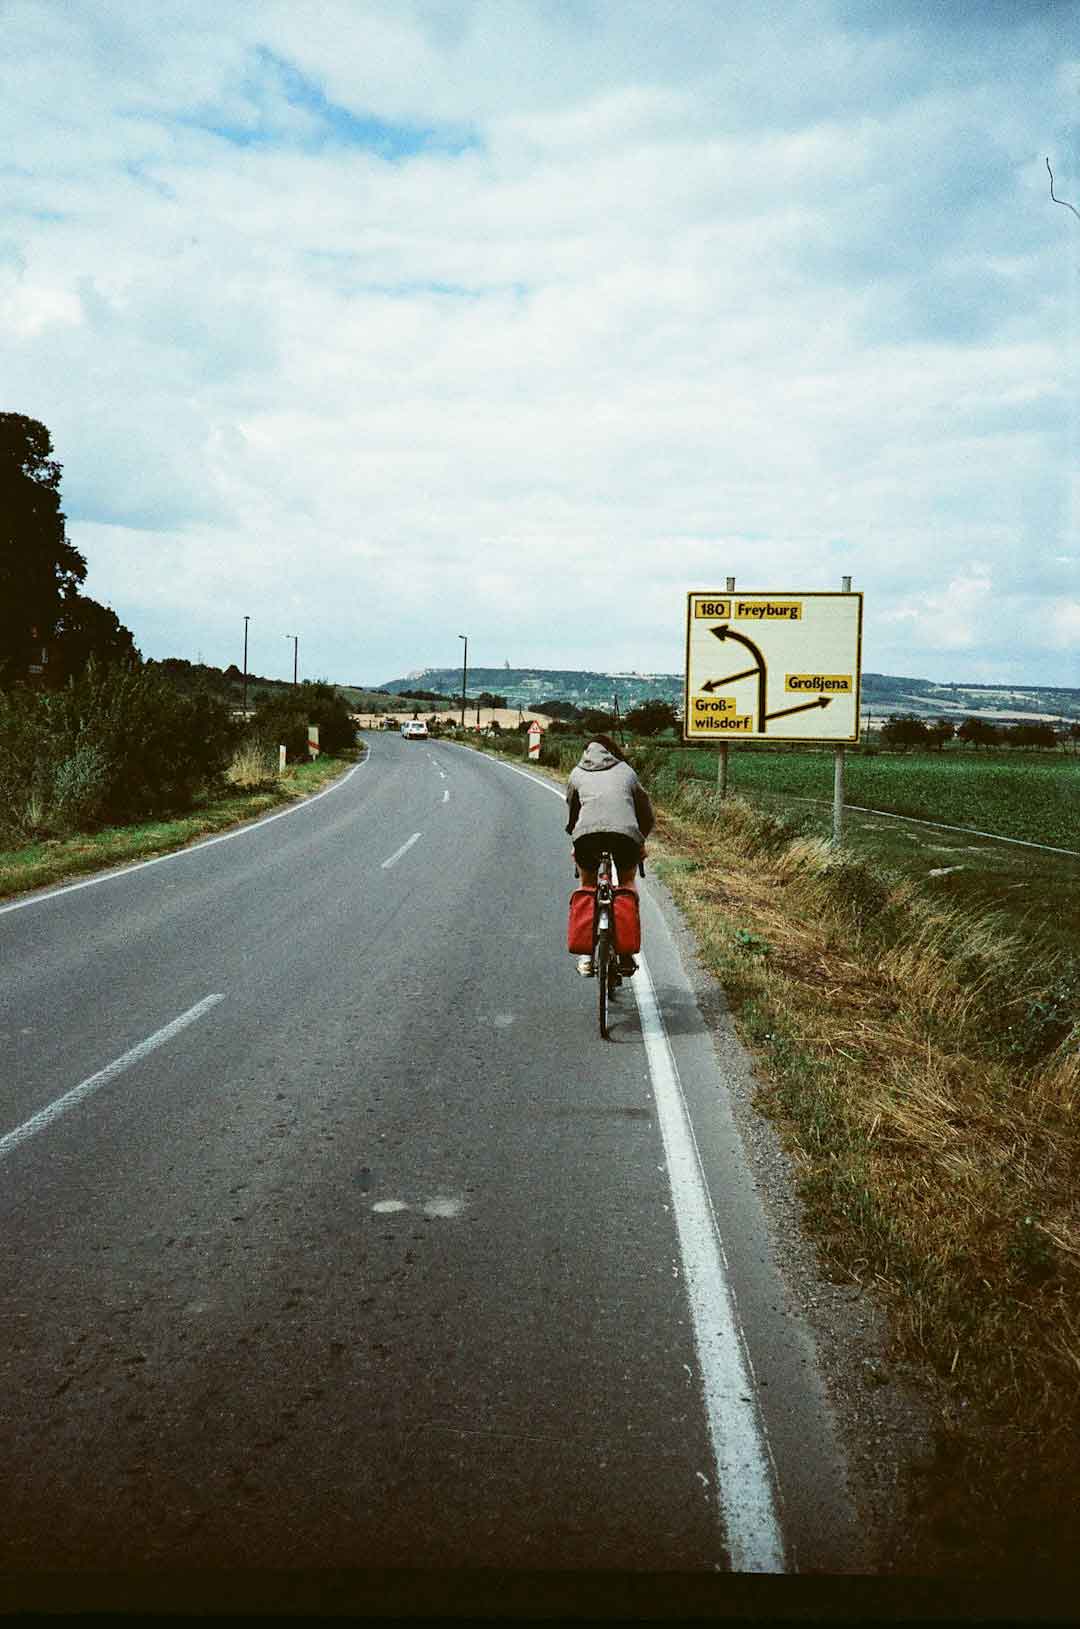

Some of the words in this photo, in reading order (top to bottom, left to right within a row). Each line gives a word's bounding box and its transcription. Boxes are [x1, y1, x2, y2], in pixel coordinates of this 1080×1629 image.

[701, 603, 725, 616] 180
[738, 603, 799, 620] Freyburg
[788, 676, 849, 692] Großjena
[695, 699, 733, 711] Groß-
[695, 716, 750, 729] wilsdorf
